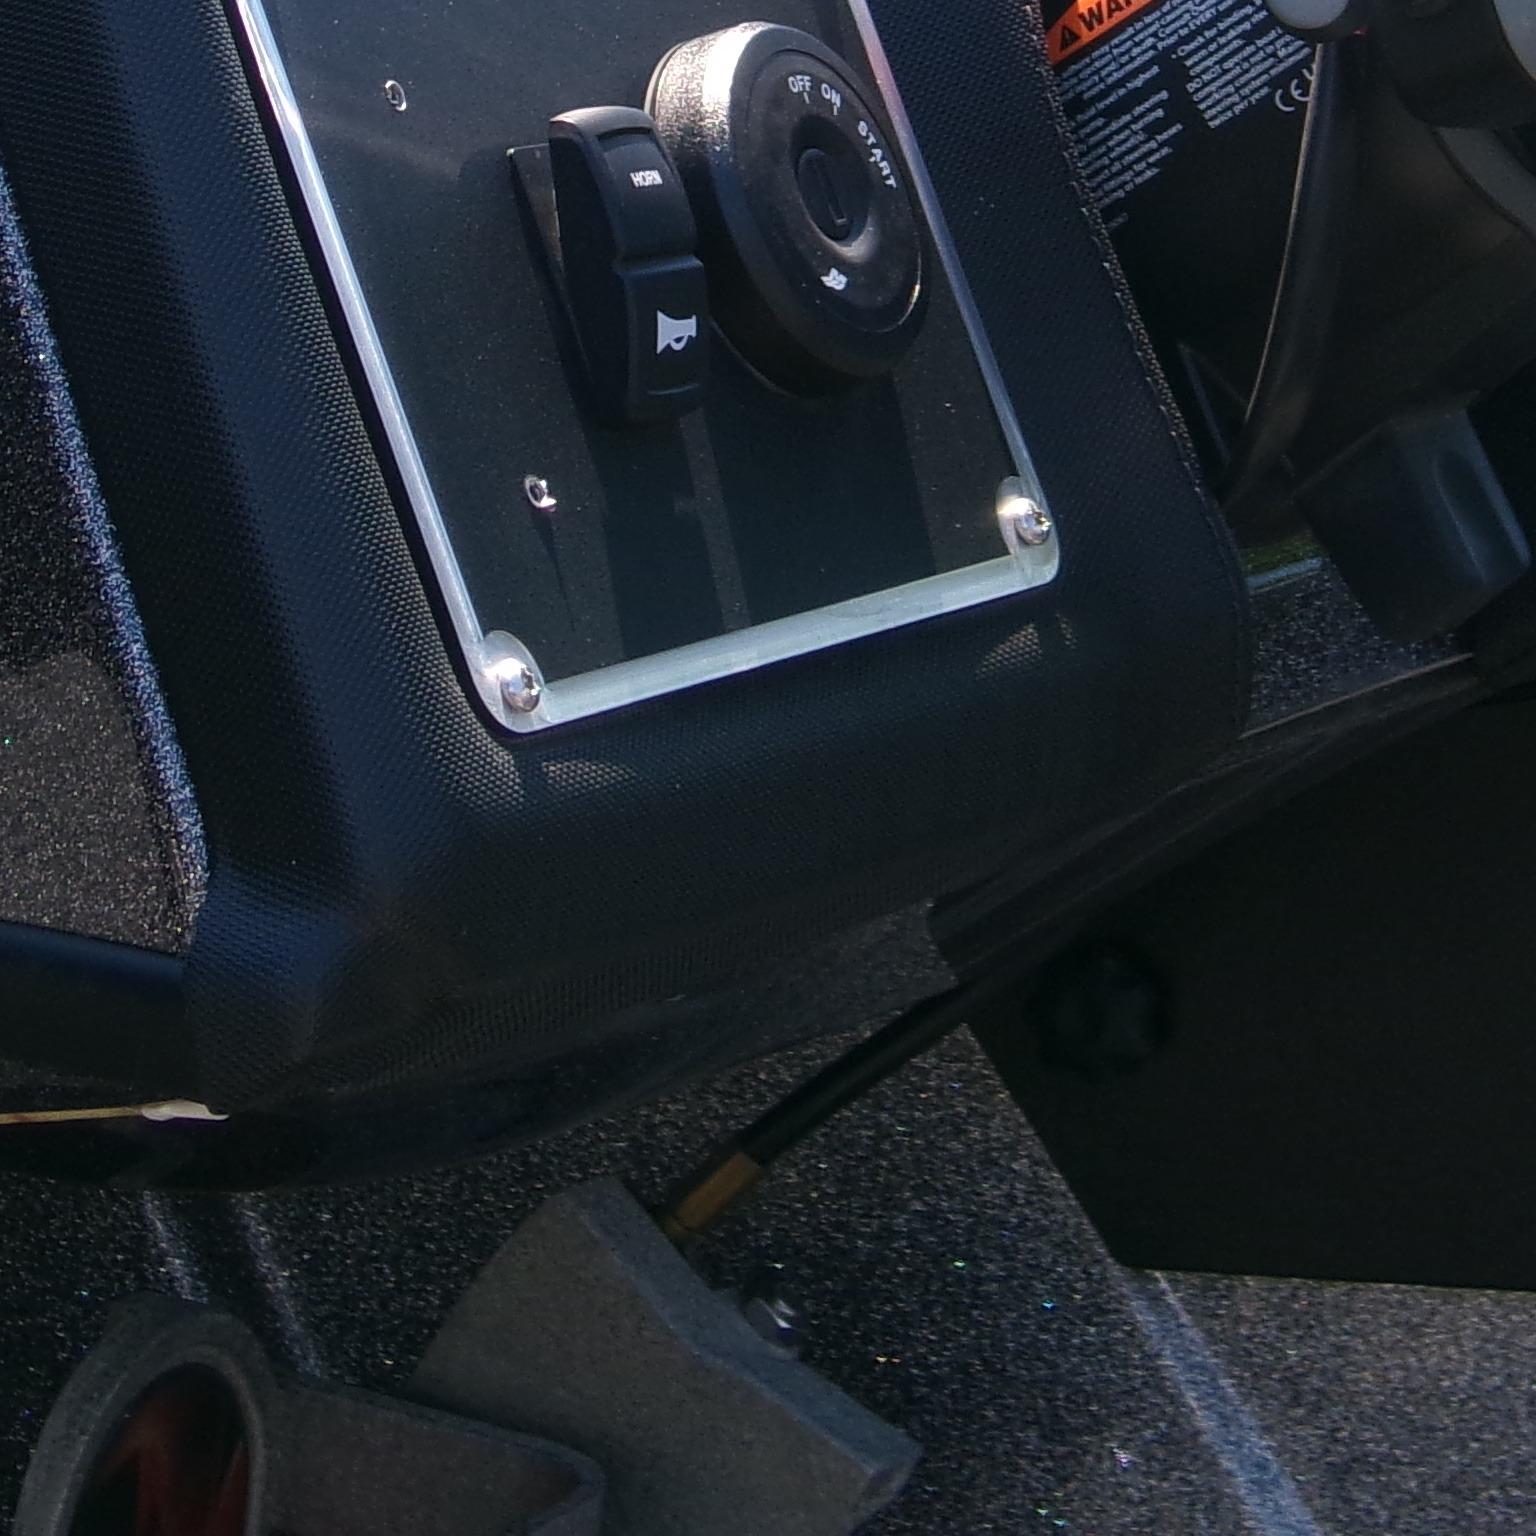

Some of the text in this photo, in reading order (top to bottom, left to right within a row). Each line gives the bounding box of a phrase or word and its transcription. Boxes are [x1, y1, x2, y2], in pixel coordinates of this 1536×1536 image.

[787, 74, 812, 93] OFF
[820, 83, 841, 108] ON
[857, 120, 897, 189] START
[629, 169, 663, 188] HORN
